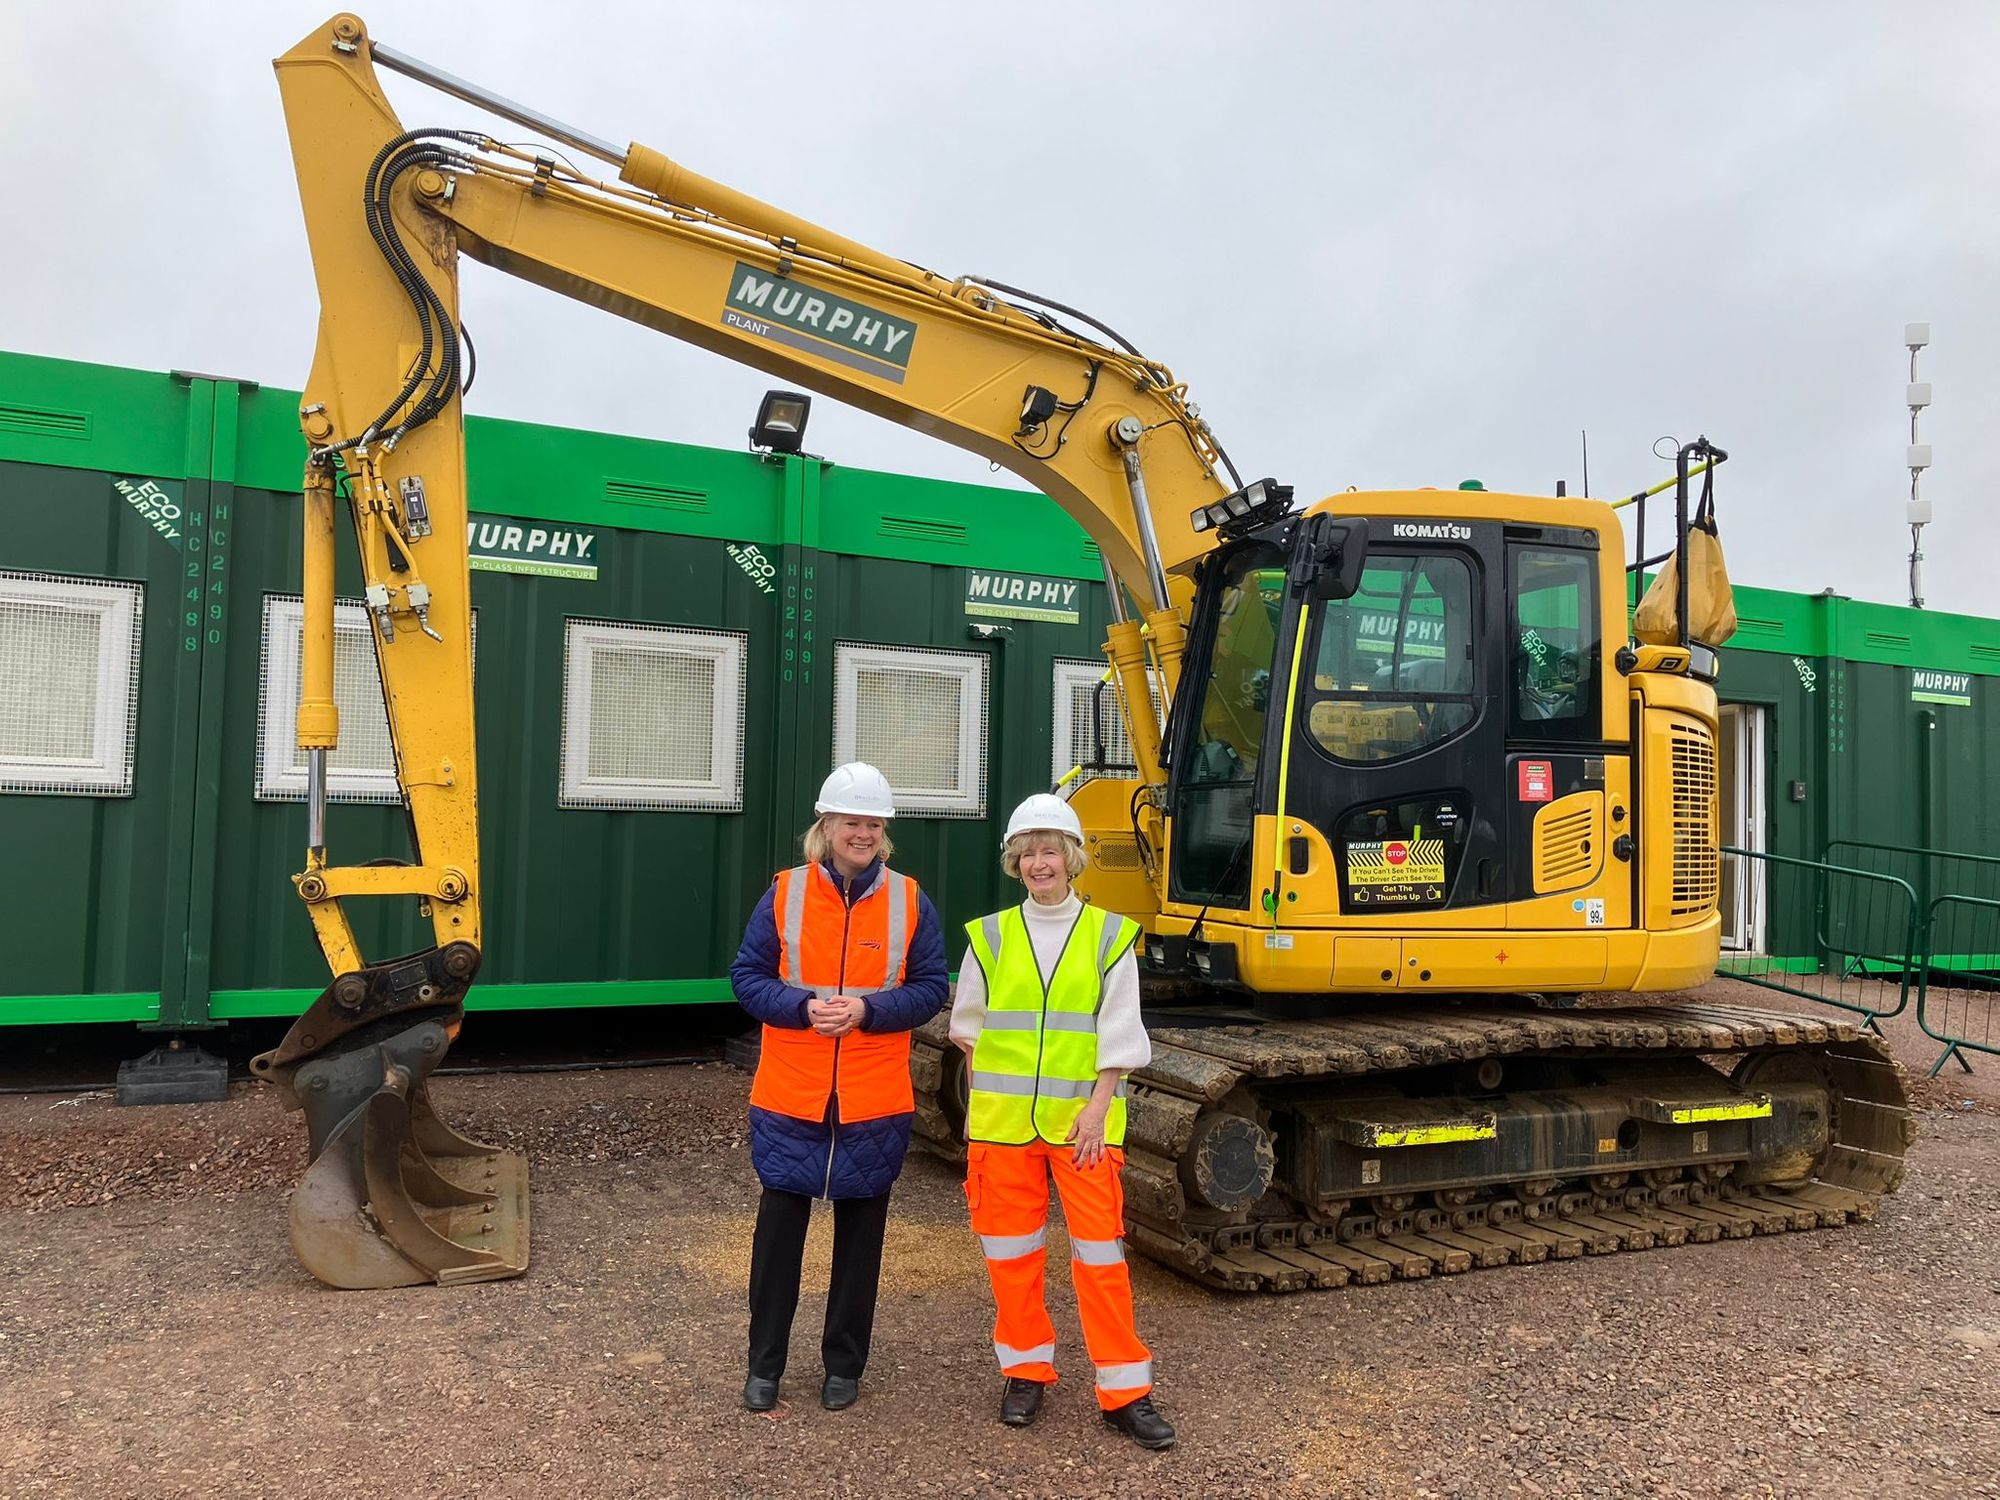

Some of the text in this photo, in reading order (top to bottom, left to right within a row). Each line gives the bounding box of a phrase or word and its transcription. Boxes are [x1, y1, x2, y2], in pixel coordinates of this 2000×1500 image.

[727, 314, 770, 336] PLANT
[735, 275, 909, 353] MURPHY
[114, 479, 182, 539] MURPHY
[137, 480, 181, 519] ECO
[1393, 522, 1472, 540] KOMATSU
[469, 561, 594, 579] D-CLASS INFRASTRUCTURE
[726, 543, 776, 595] MURPHY
[743, 544, 776, 578] ECO
[968, 574, 1077, 605] MURPHY
[1521, 633, 1547, 667] URPHY
[1525, 629, 1547, 654] ECO
[1913, 671, 1969, 692] MURPHY
[1373, 867, 1390, 875] Can't
